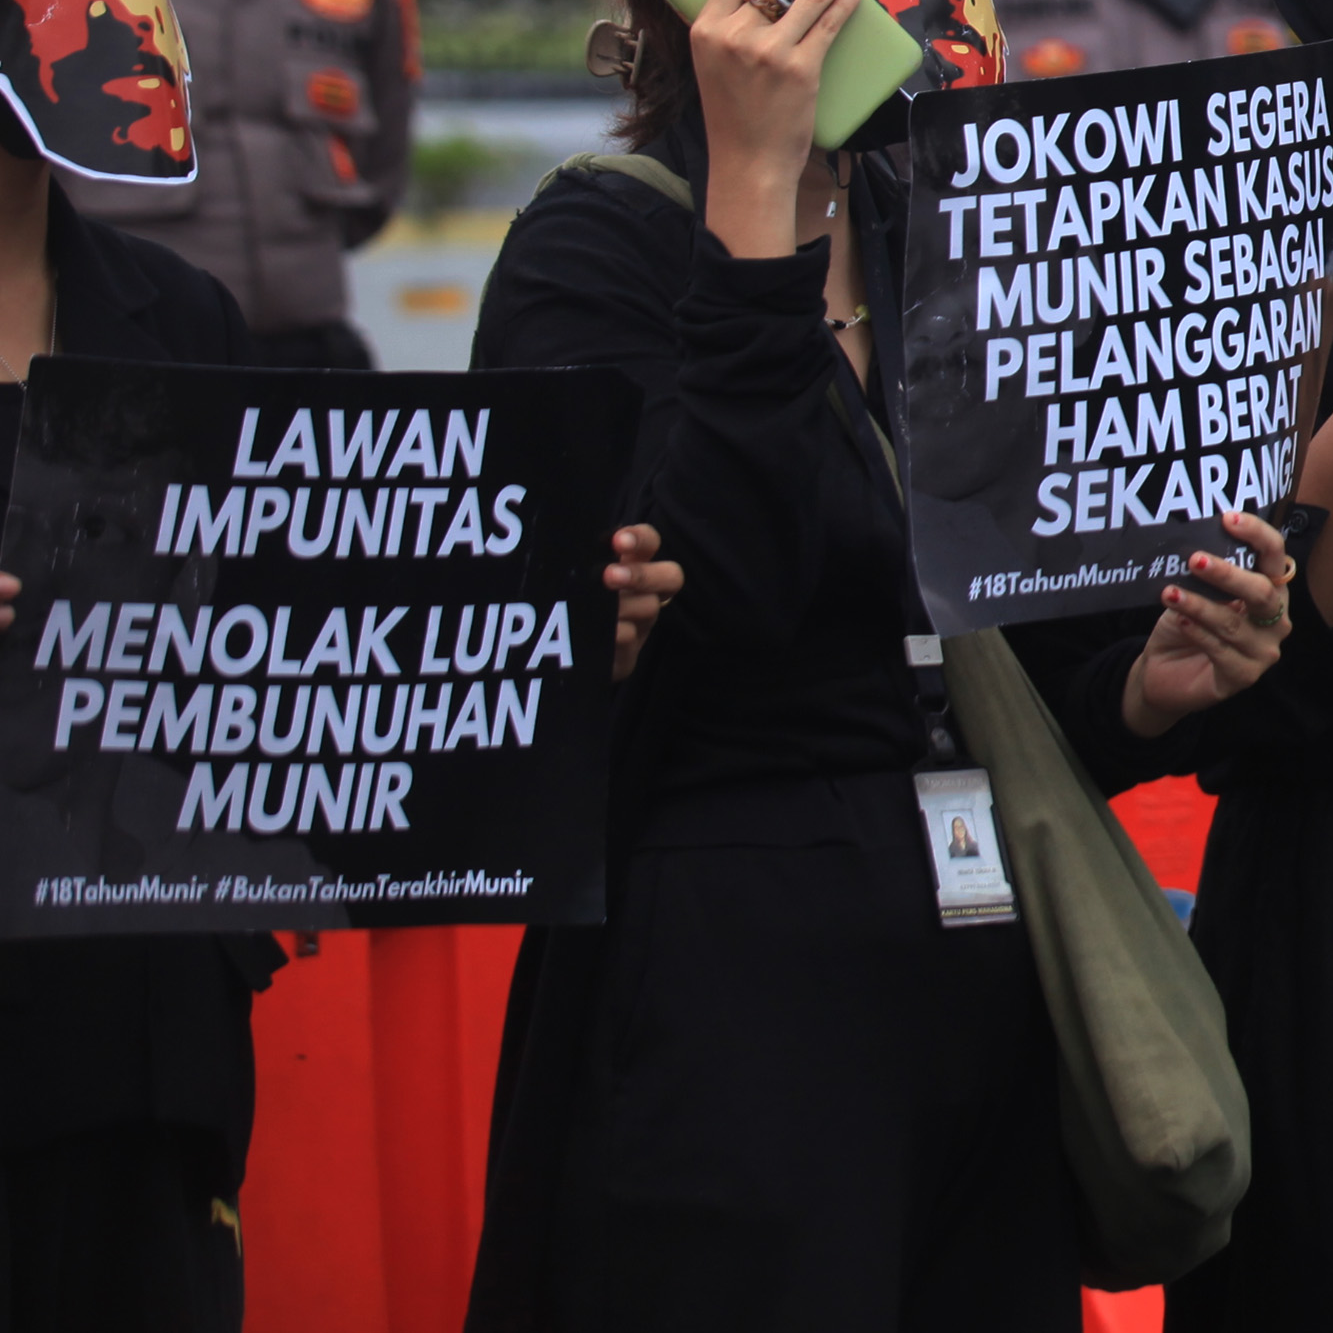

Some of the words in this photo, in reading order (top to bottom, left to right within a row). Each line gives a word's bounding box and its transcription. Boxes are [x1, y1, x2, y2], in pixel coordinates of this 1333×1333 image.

[951, 99, 1182, 188] JOKOWI
[1207, 78, 1330, 156] SEGERA
[939, 165, 1227, 259] TETAPKAN
[976, 248, 1172, 331] MUNIR
[1184, 218, 1324, 304] SEBAGAI
[986, 288, 1322, 401] PELANGGARAN
[234, 409, 489, 478] LAWAN
[1045, 389, 1185, 465] HAM
[1198, 364, 1301, 446] BERAT
[156, 485, 526, 557] IMPUNITAS
[1032, 431, 1297, 536] SEKARANG!
[969, 560, 1143, 601] #18TahunMunir
[35, 600, 408, 675] MENOLAK
[420, 602, 572, 673] LUPA
[55, 679, 541, 753] PEMBUNUHAN
[178, 763, 412, 831] MUNIR
[36, 876, 208, 904] #18TahunMunir
[215, 870, 533, 901] #BukanTahunTerakhirMunir
